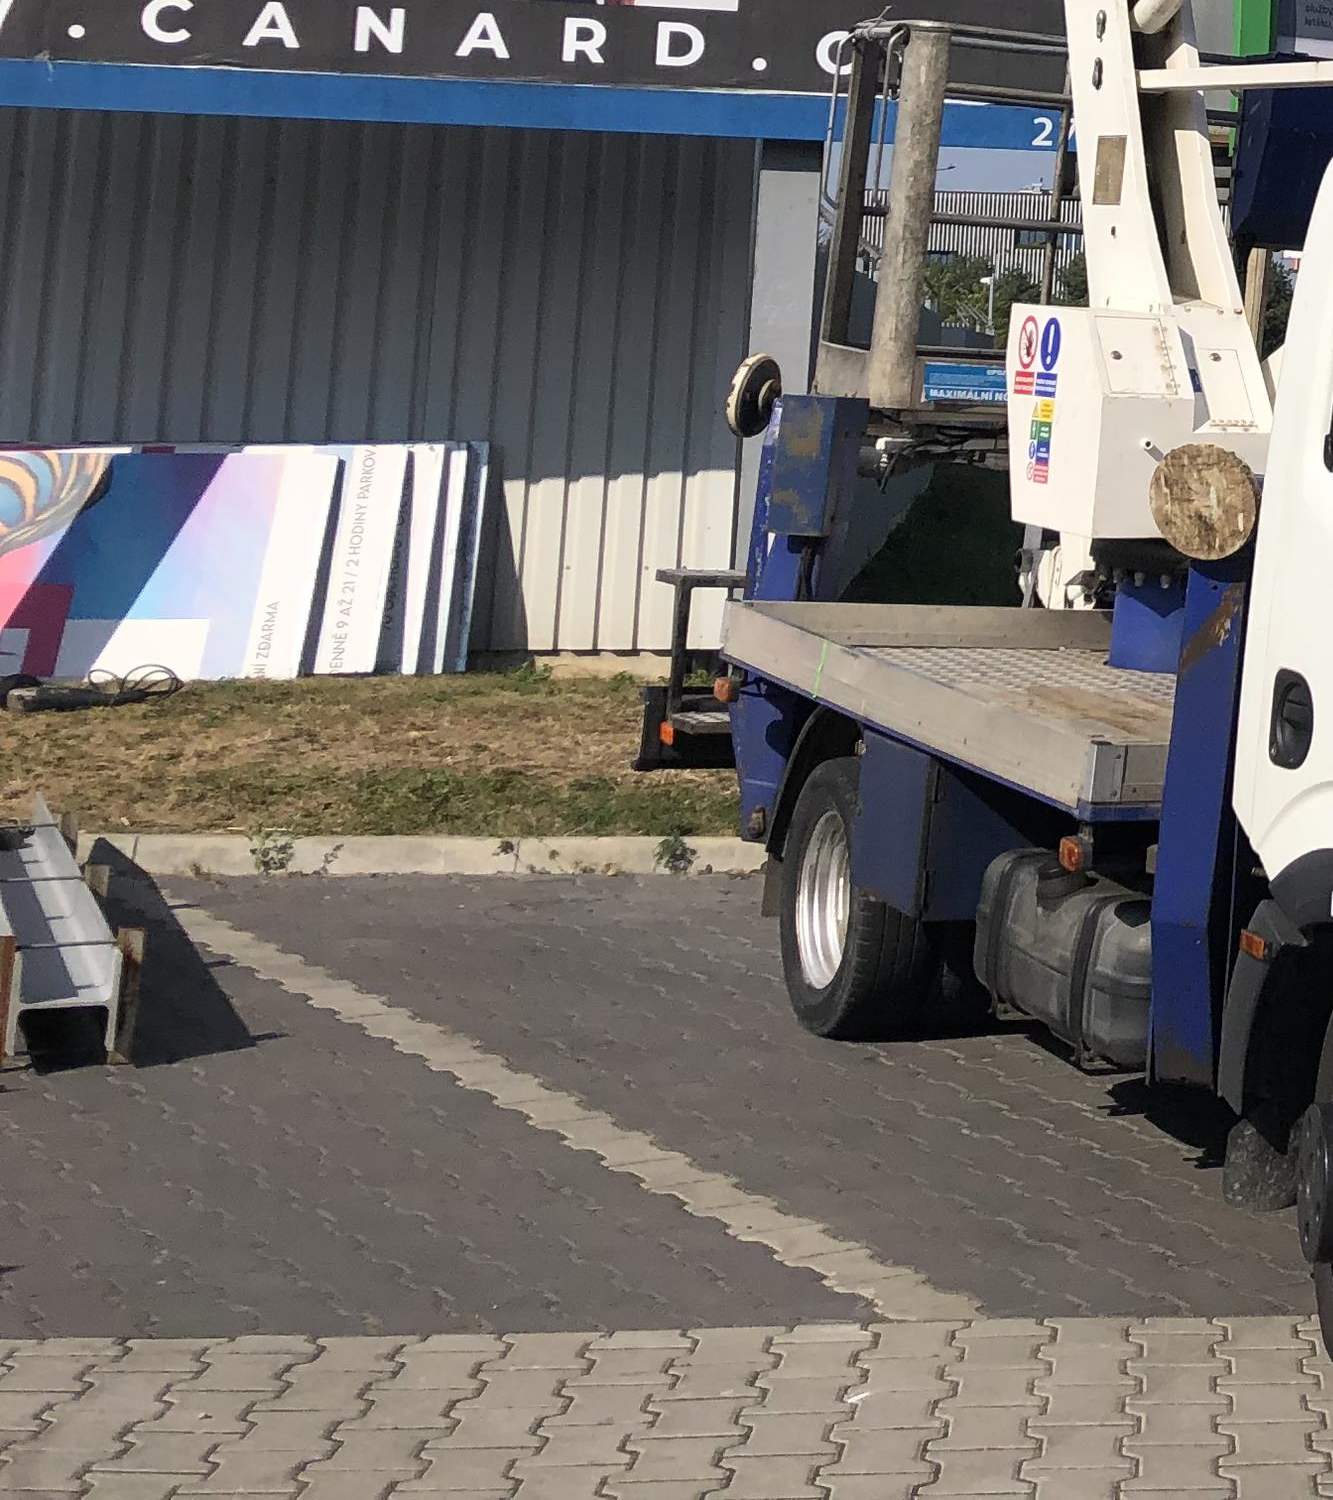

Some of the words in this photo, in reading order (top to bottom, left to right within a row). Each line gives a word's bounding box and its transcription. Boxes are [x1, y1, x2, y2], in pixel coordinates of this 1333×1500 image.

[357, 445, 377, 500] PARKOV
[348, 503, 369, 556] HODINY
[256, 601, 280, 659] ZDARMA
[340, 597, 352, 618] AŽ
